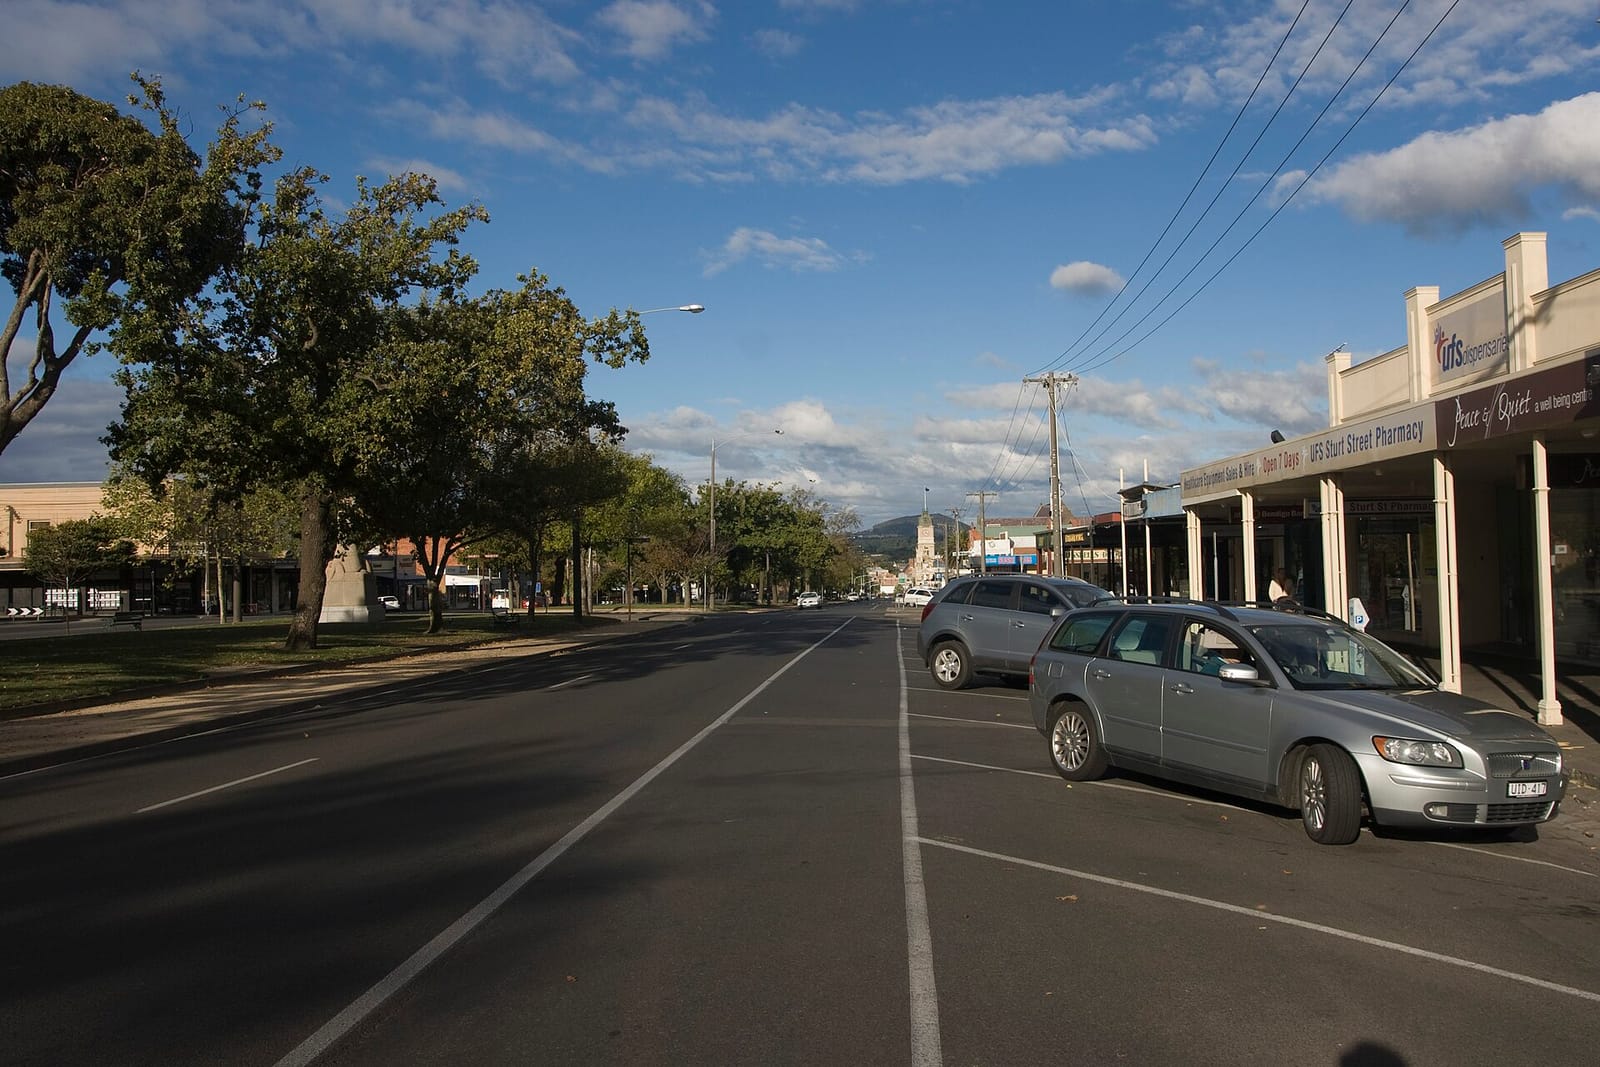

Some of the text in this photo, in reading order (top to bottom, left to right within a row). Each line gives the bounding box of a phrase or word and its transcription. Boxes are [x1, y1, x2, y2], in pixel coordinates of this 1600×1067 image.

[1442, 333, 1463, 372] ufs
[1534, 387, 1593, 413] a well being centre
[1447, 395, 1479, 447] Peace
[1498, 389, 1532, 431] Quiet
[1310, 420, 1424, 463] UFS Sturt Street Pharmacy
[1225, 466, 1238, 482] Sales
[1263, 451, 1299, 477] Open 7 Days
[1350, 501, 1433, 512] Sturt St Pharmac
